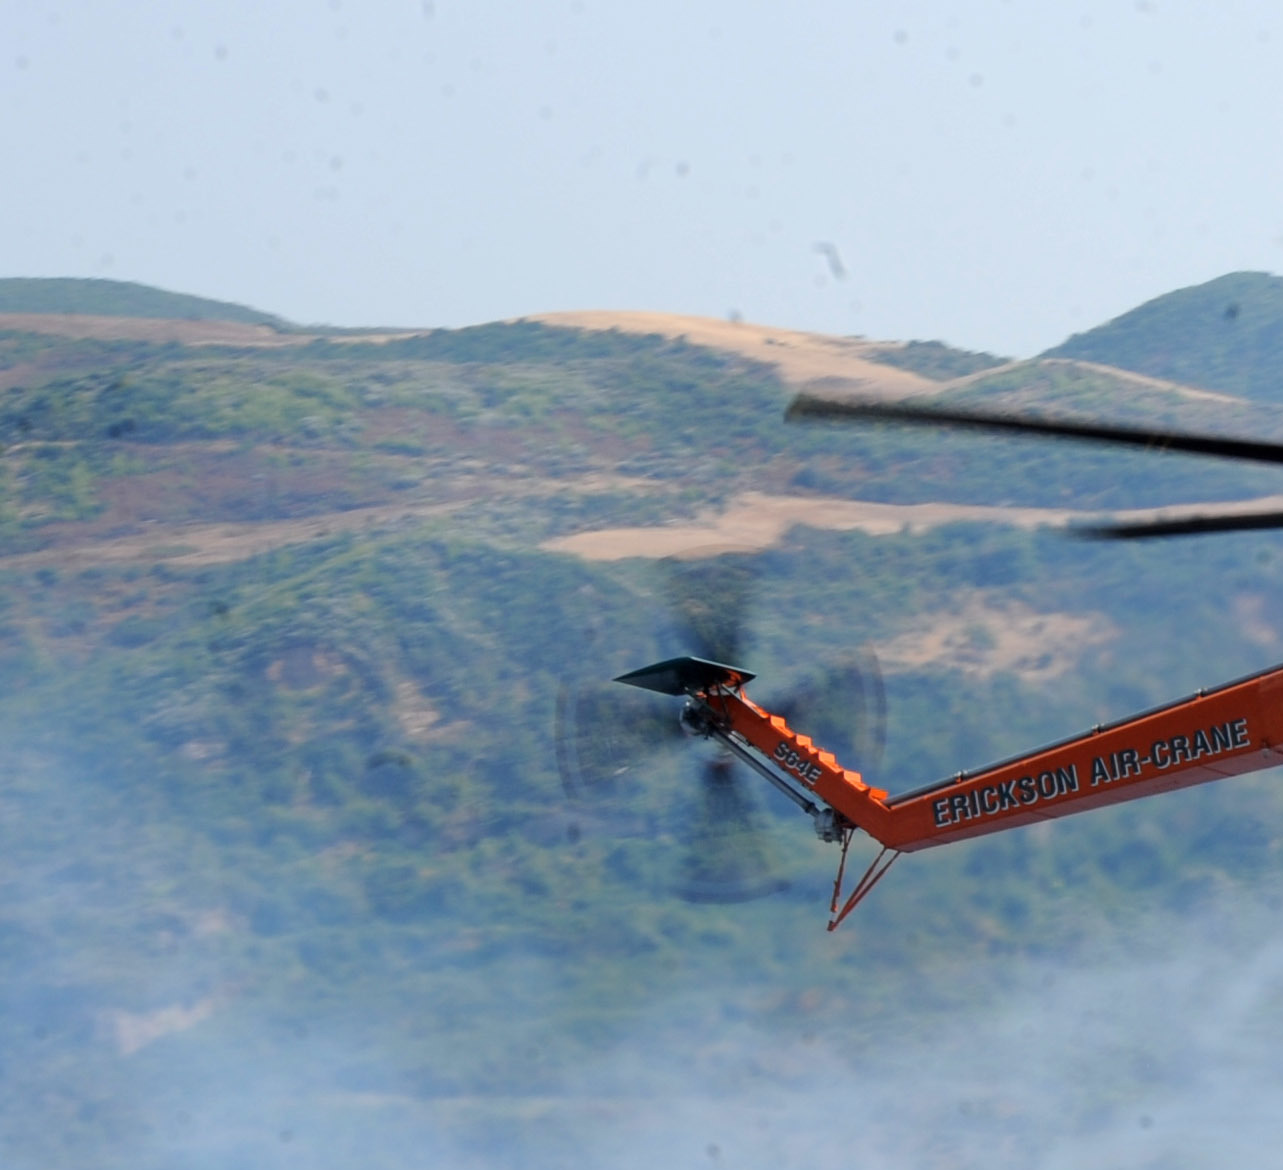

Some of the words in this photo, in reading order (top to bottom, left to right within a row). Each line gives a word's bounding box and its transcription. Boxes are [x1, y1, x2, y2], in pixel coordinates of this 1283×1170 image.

[774, 741, 822, 785] S64E
[933, 765, 1079, 828] ERICKSON
[1090, 718, 1251, 787] AIR-CRANE
